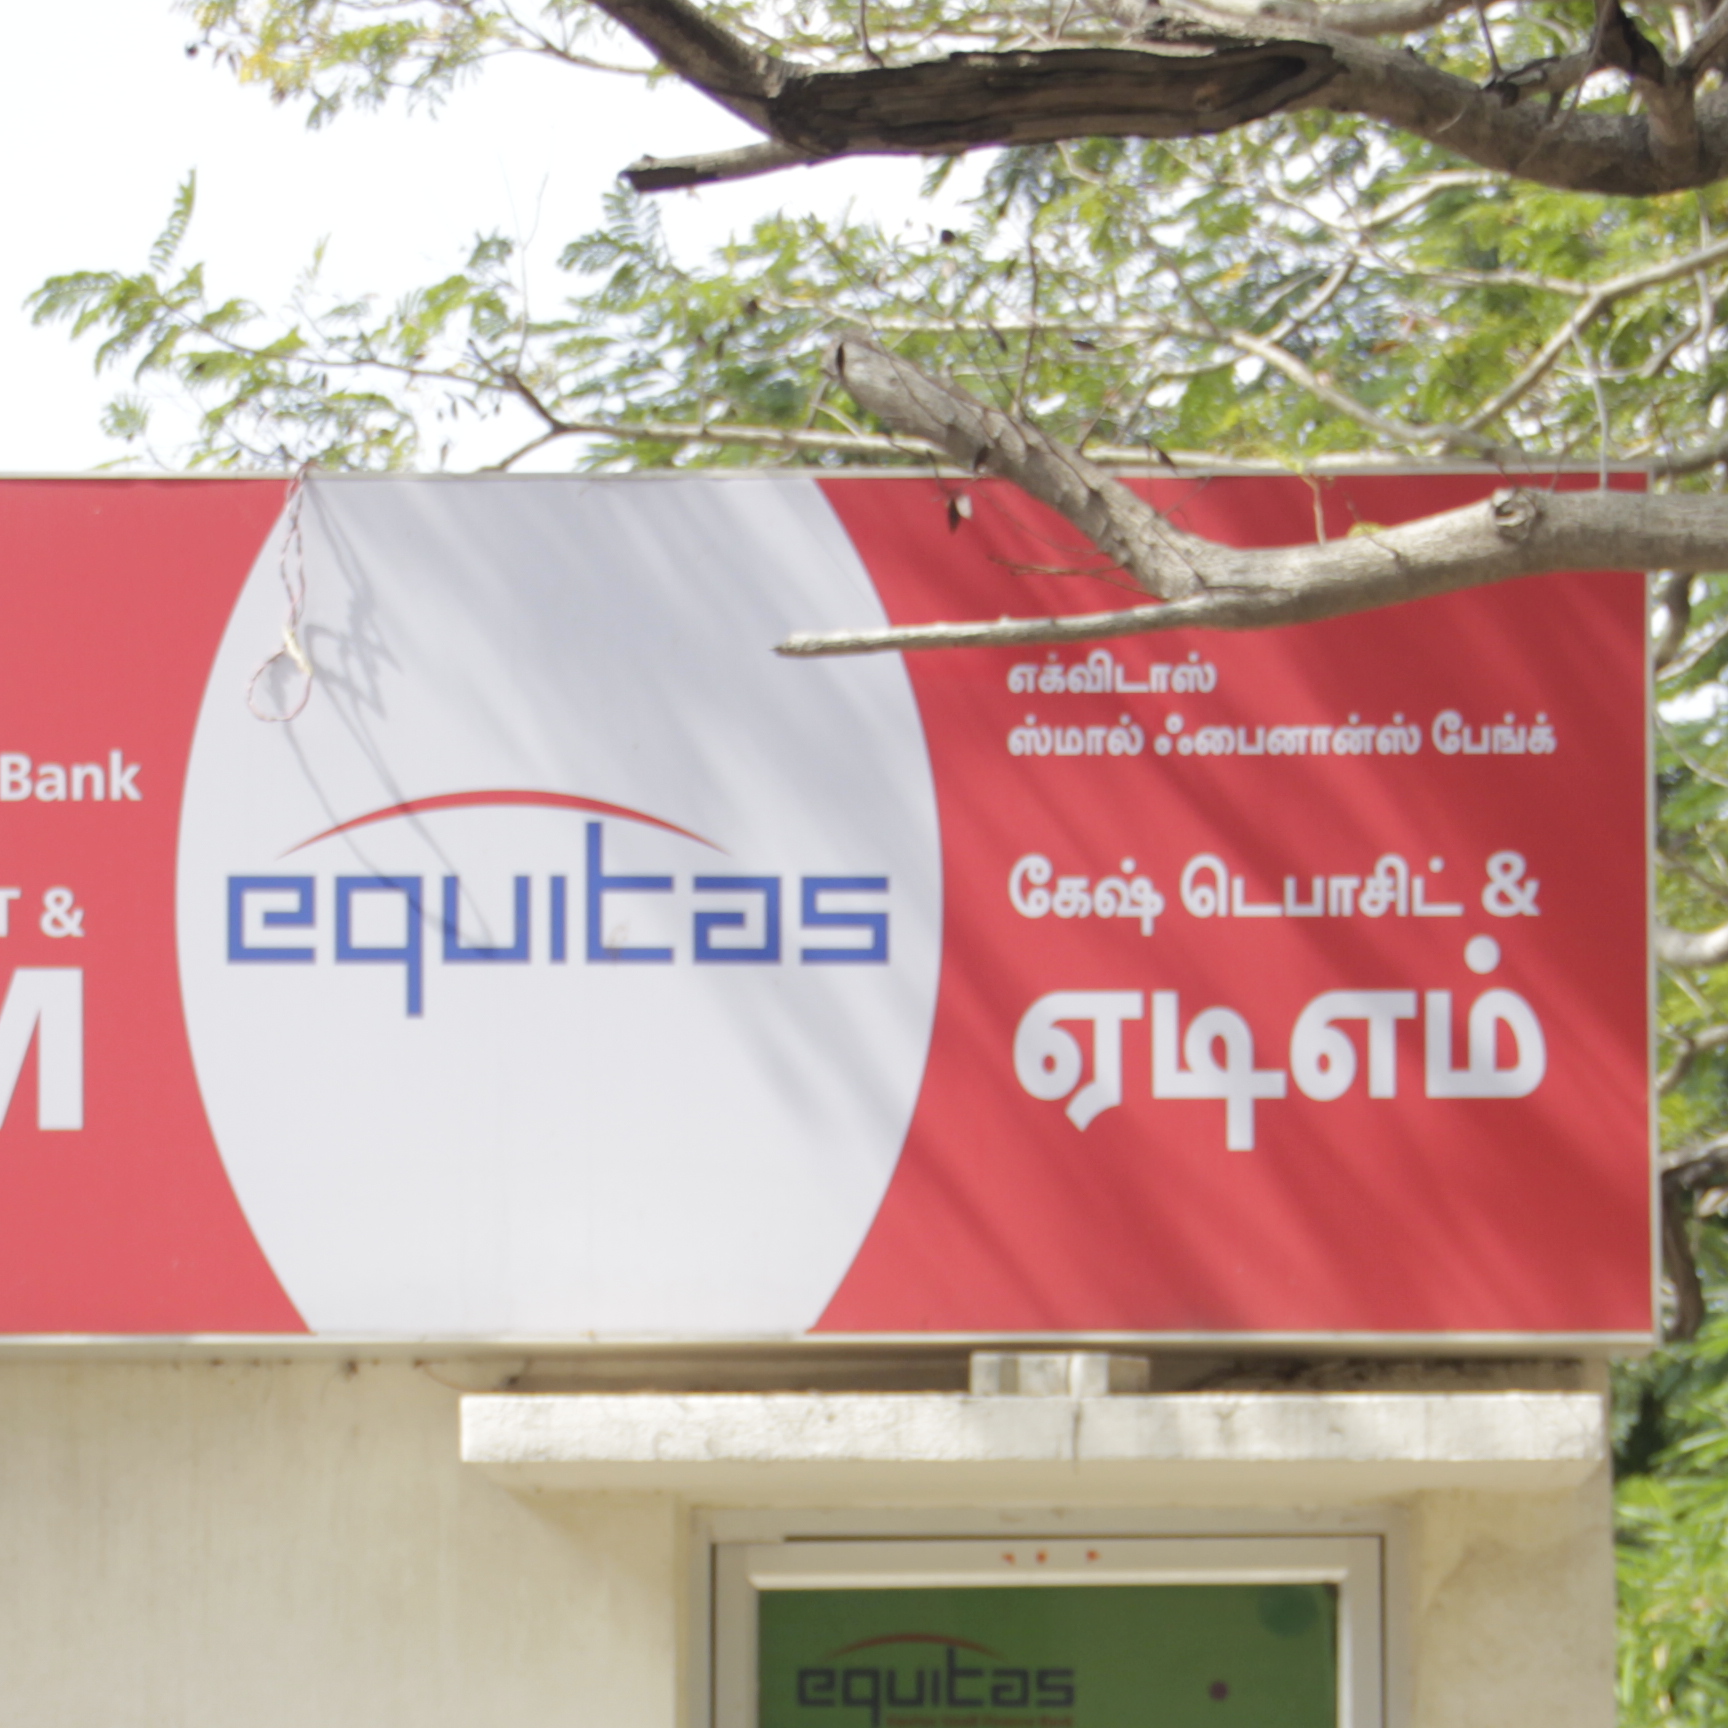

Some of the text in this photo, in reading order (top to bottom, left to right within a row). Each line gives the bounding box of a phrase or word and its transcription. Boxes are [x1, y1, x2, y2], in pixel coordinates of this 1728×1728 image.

[1006, 648, 1218, 695] எக்விடாஸ்
[1006, 710, 1558, 757] ஸ்மால் ஃபைனான்ஸ் பேங்க்
[39, 885, 85, 940] &
[225, 821, 890, 1018] equitas
[1007, 851, 1541, 937] கேஷ் டெபாசிட் &
[1012, 934, 1548, 1153] ஏடிஎம்
